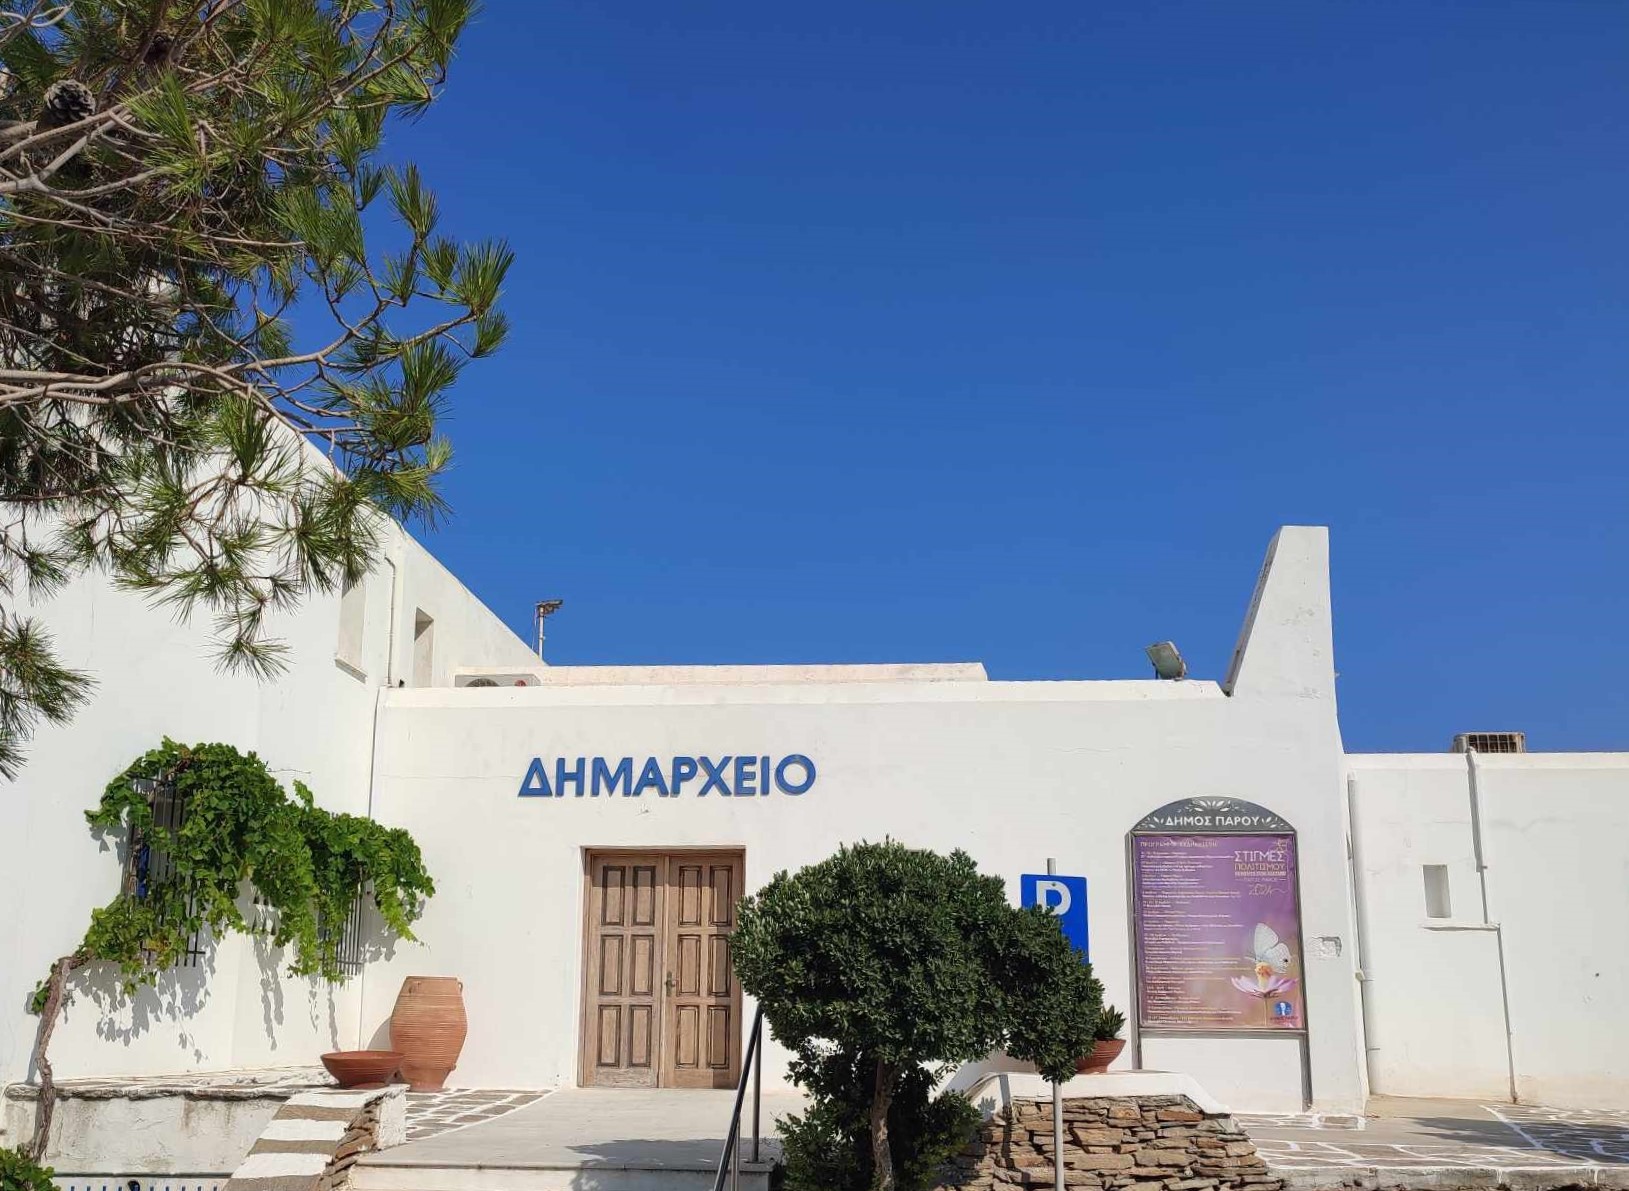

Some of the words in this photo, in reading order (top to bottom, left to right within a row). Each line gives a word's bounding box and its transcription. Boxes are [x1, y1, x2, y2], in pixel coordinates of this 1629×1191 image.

[518, 754, 816, 797] ΔΗΜΑΡΧΕΙΟ
[1164, 816, 1212, 826] ΔΗΜΟΣ
[1215, 816, 1260, 826] ΠΑΡΟΥ
[1234, 850, 1285, 862] ΣΤΙΓΜΕΣ
